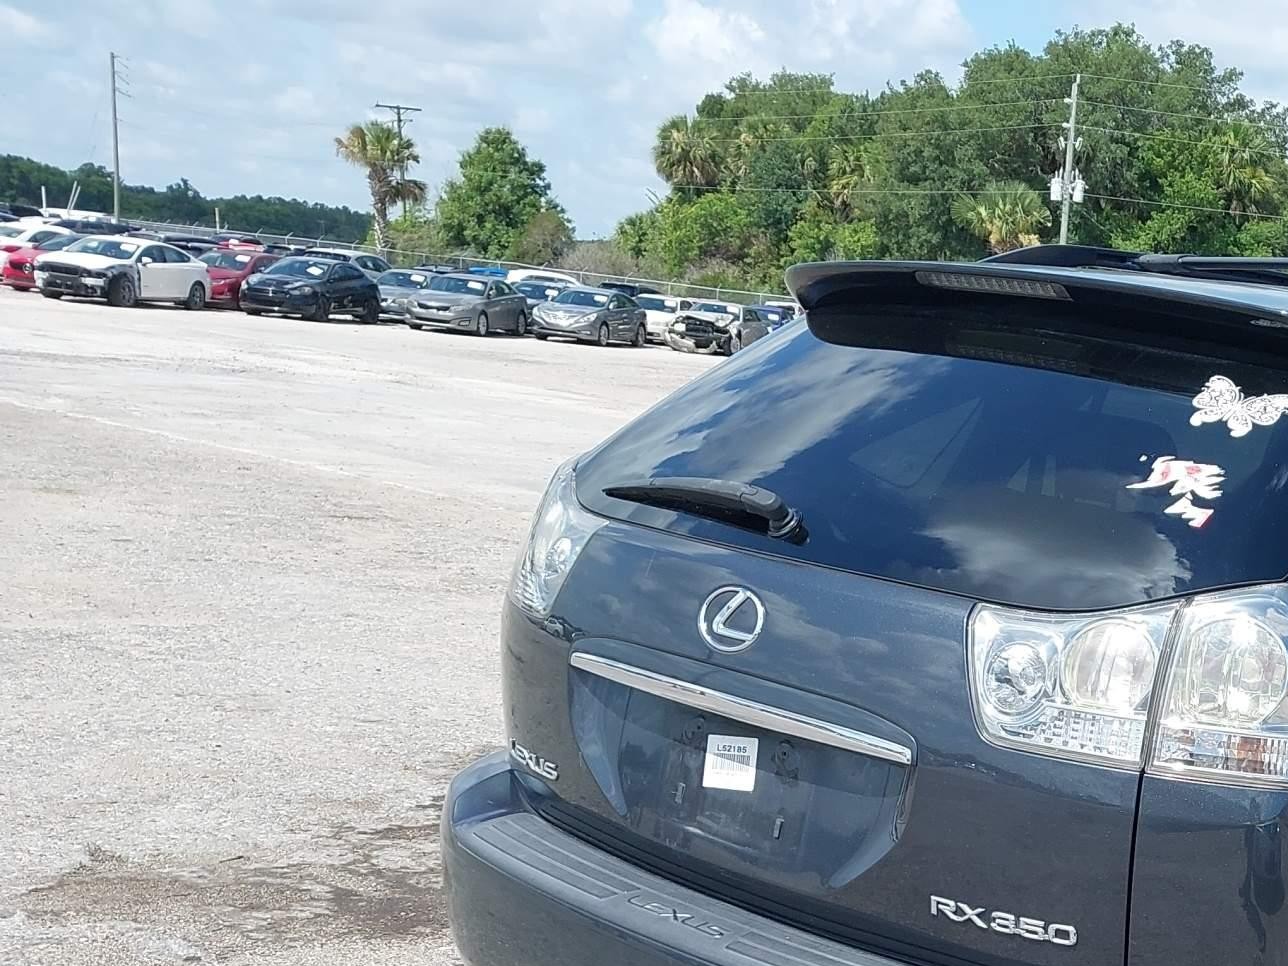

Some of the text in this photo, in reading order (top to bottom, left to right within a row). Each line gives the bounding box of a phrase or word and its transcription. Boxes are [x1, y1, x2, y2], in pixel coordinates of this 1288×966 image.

[509, 737, 560, 781] LEXUS
[716, 743, 749, 754] L52185
[627, 894, 732, 938] LEXUS
